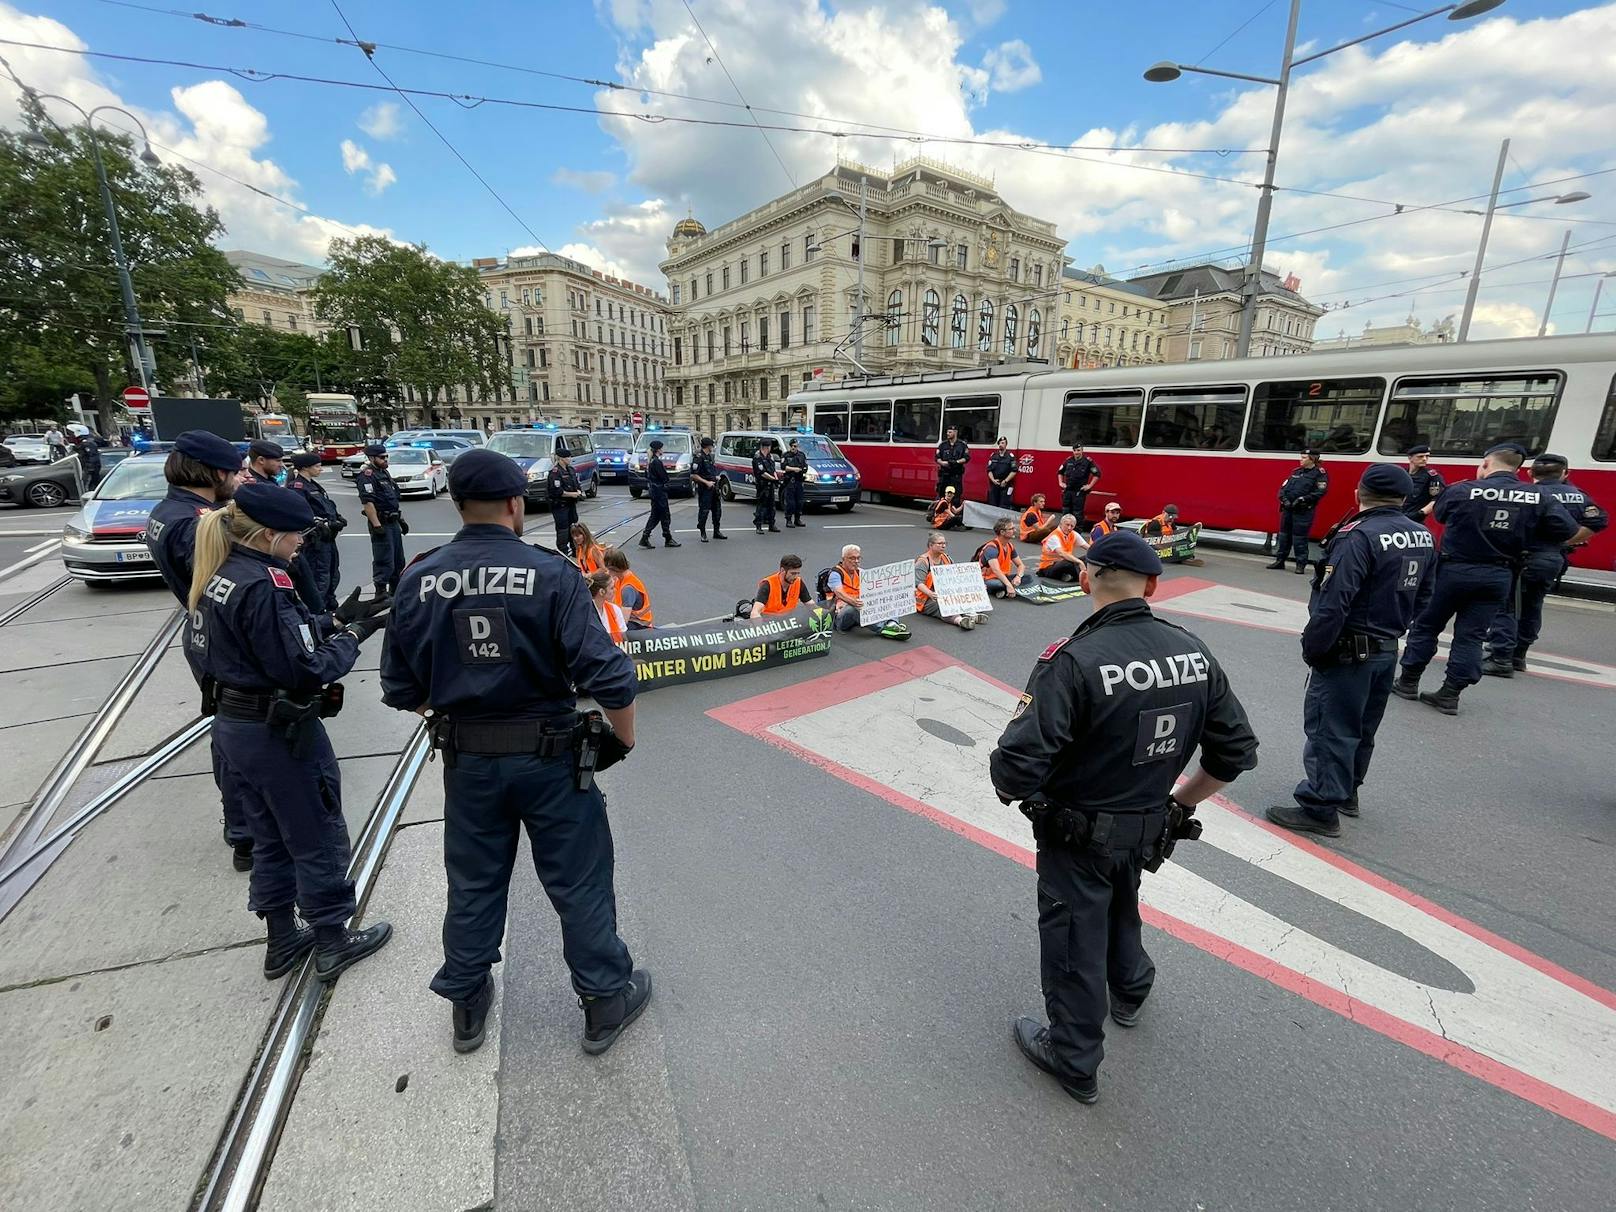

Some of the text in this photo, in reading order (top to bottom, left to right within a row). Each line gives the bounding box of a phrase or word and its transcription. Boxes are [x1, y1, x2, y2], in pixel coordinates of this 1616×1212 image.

[1309, 383, 1321, 395] 2
[1469, 488, 1540, 504] POLIZEI
[1494, 509, 1509, 521] D
[1489, 521, 1509, 529] 142
[1408, 561, 1418, 575] D
[420, 566, 536, 602] POLIZEI
[1403, 577, 1417, 587] 142
[192, 610, 204, 630] D
[469, 616, 491, 639] D
[645, 636, 688, 653] RASEN
[690, 634, 703, 647] IN
[705, 632, 726, 646] DIE
[726, 617, 802, 641] KLIMAHÖLLE.
[468, 643, 500, 657] 142
[776, 637, 804, 651] LETZTE
[691, 652, 726, 673] VOM
[731, 643, 766, 667] GAS!
[1154, 714, 1177, 739] D
[1146, 738, 1177, 757] 142
